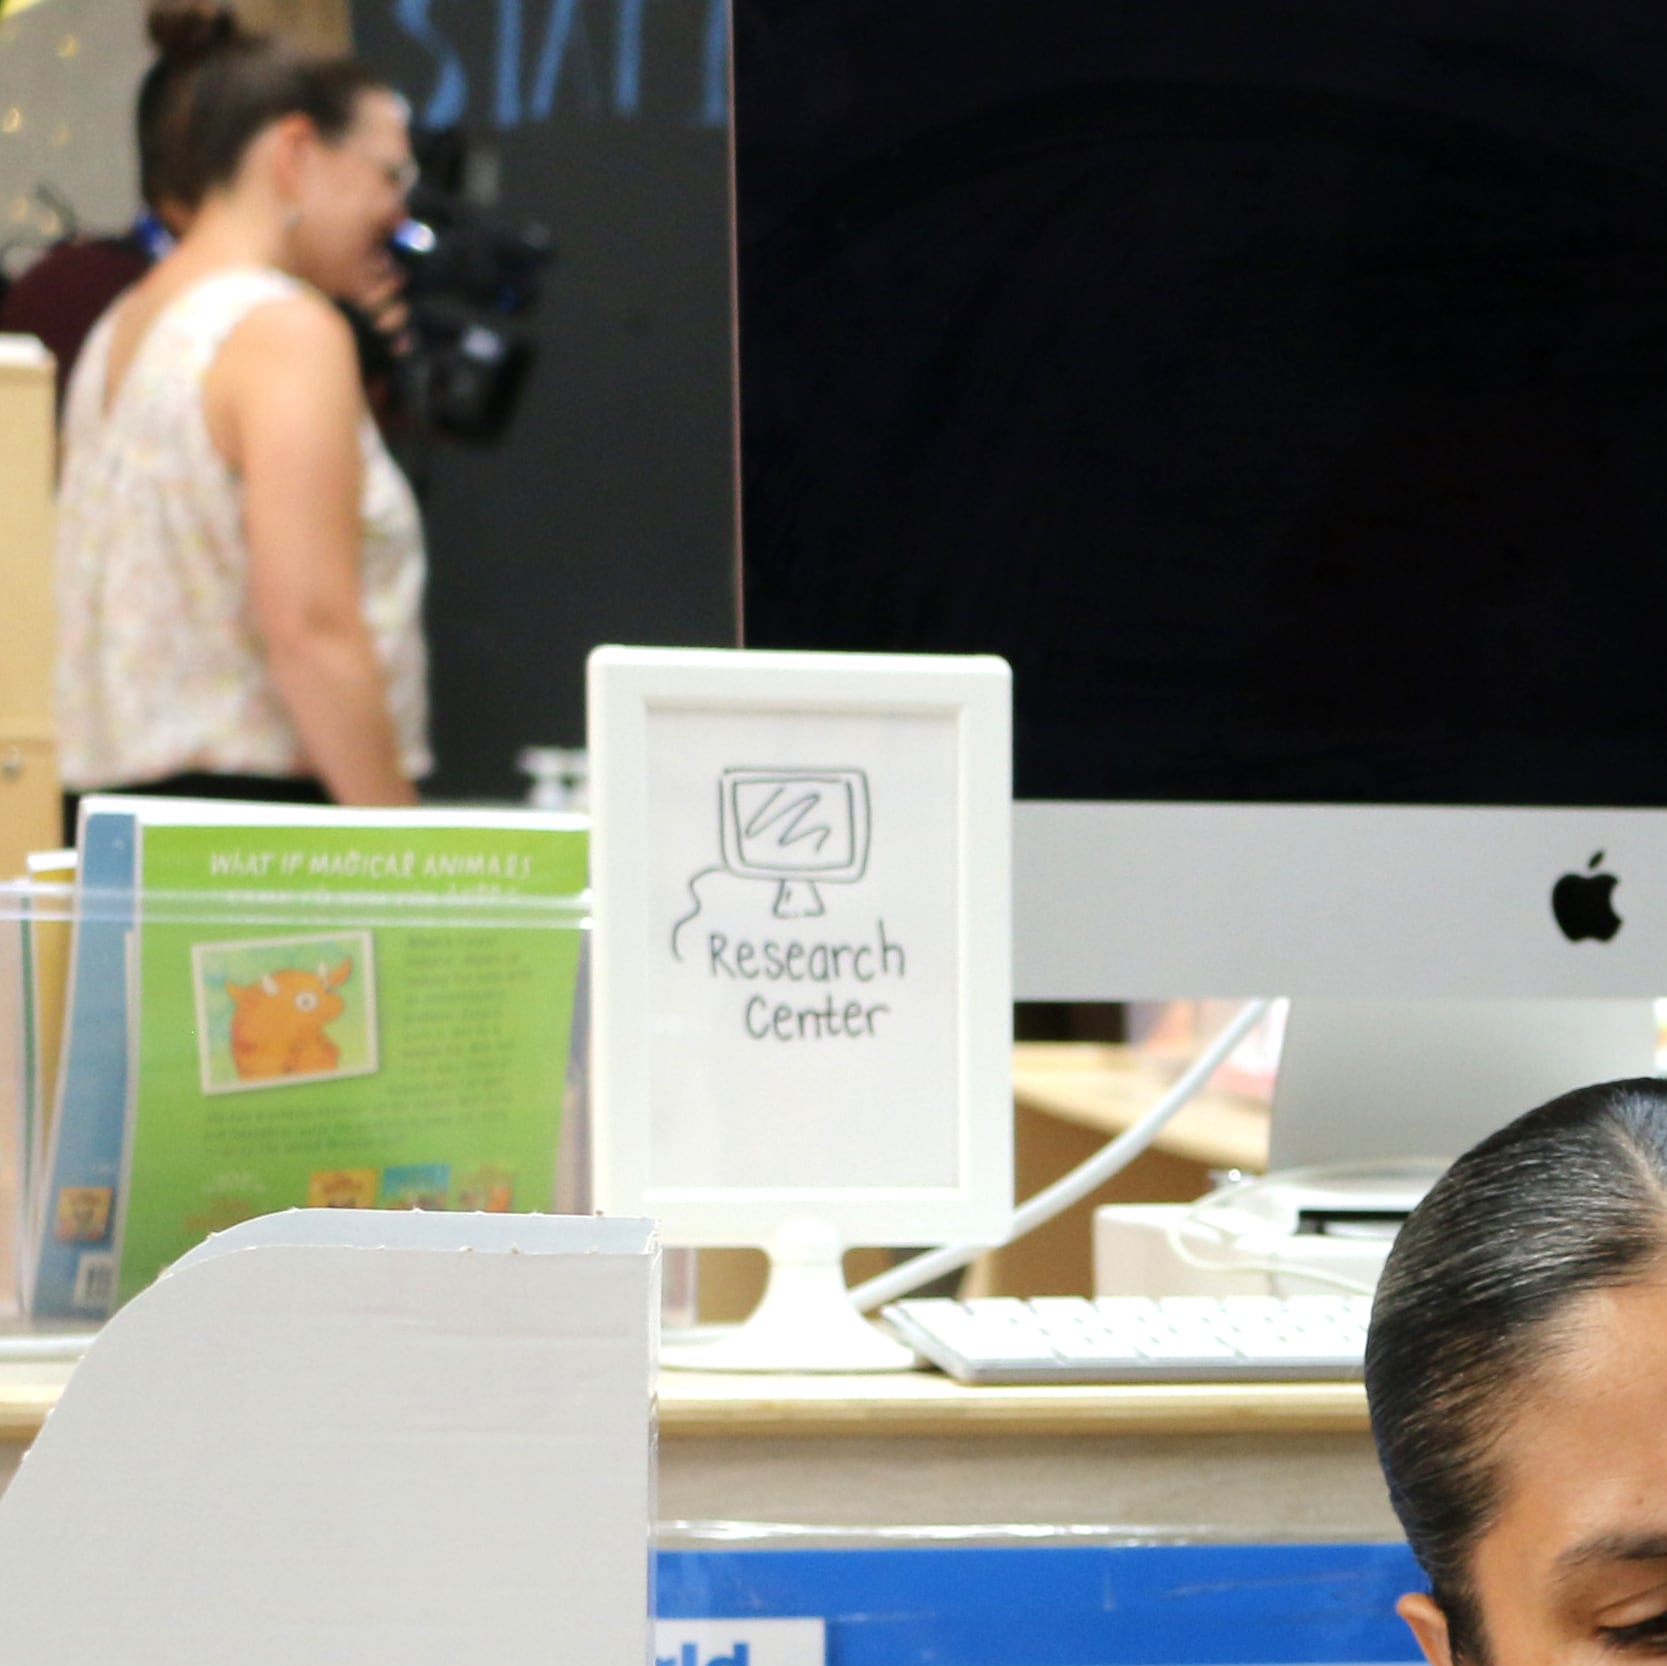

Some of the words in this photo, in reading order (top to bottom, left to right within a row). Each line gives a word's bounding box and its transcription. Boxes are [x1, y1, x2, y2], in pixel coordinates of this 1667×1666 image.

[280, 851, 304, 875] IF
[709, 918, 905, 982] Research
[745, 993, 890, 1041] Center
